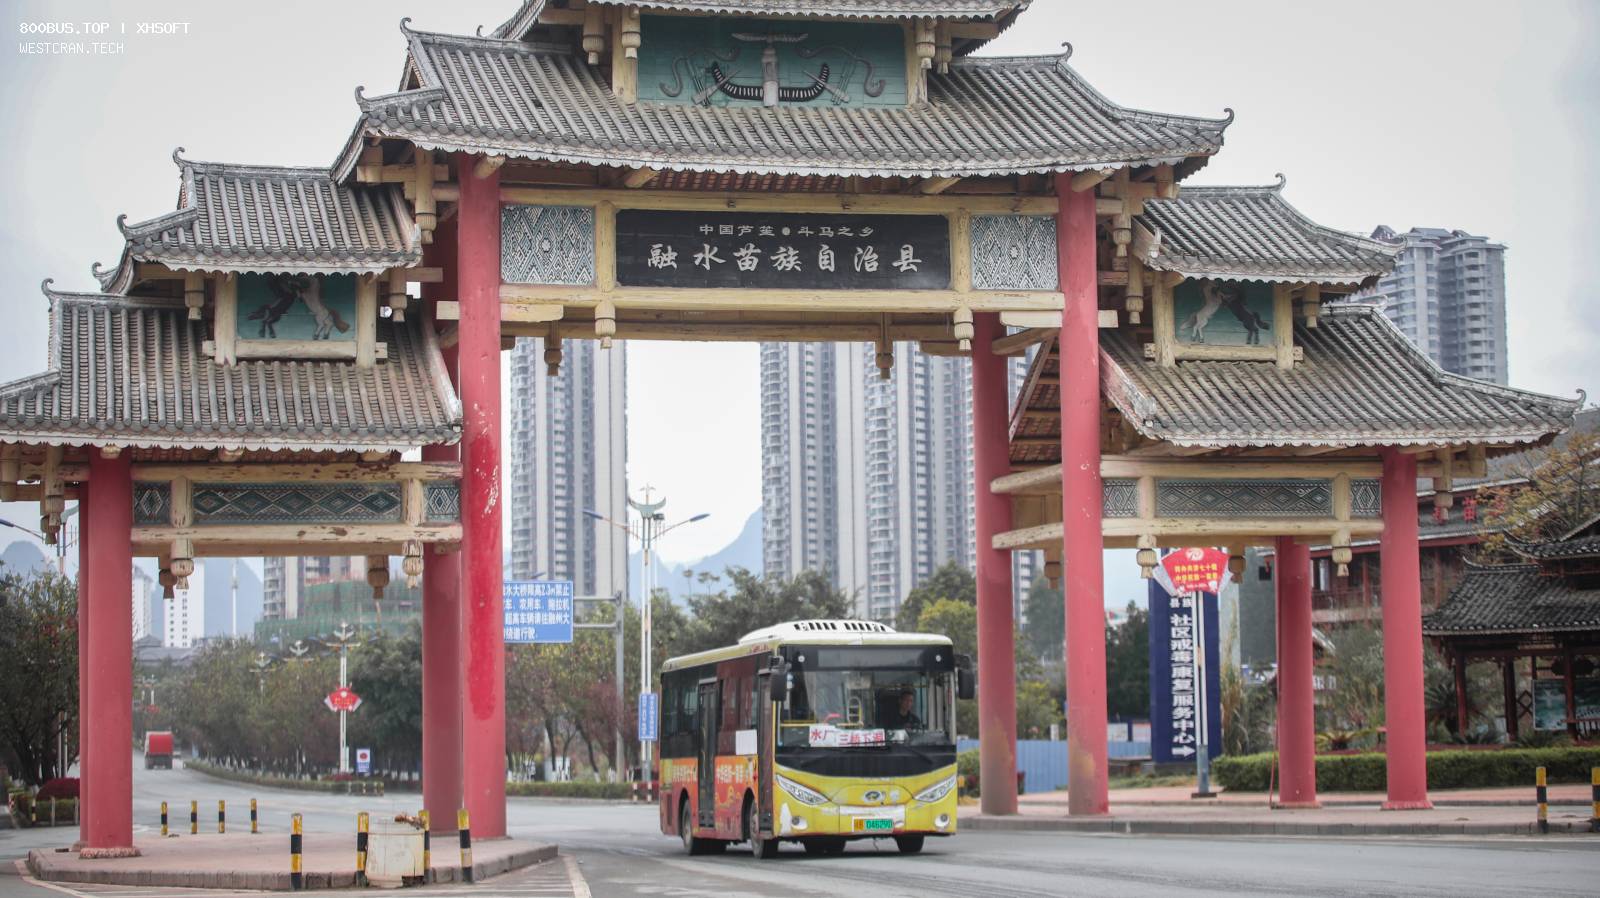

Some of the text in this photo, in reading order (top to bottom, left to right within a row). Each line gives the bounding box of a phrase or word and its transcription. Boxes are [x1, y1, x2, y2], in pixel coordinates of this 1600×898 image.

[647, 243, 922, 272] 融水苗族自治县
[504, 584, 570, 597] 水大桥限高2.3m禁止
[504, 598, 570, 611] 车、农用车、拖拉机
